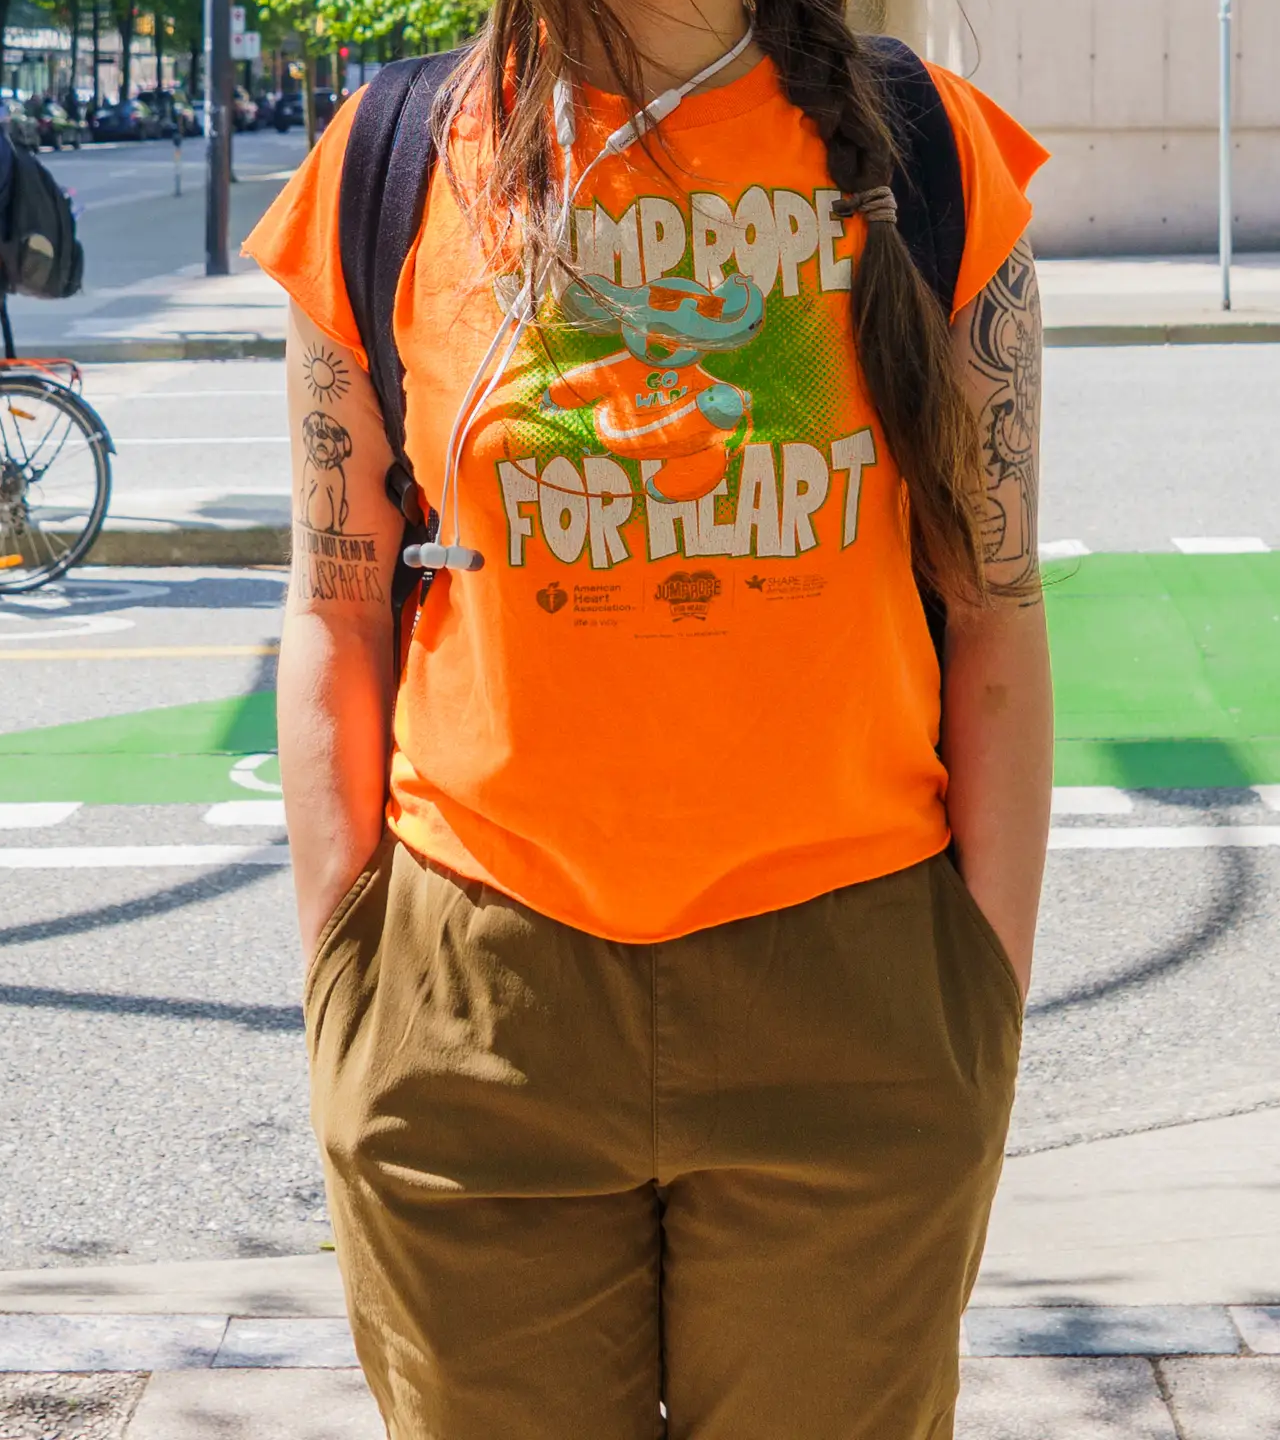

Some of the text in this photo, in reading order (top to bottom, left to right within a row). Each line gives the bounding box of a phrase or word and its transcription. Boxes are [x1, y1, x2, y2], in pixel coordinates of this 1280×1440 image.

[689, 185, 854, 298] ROPE
[646, 370, 679, 390] GO
[496, 428, 877, 570] FOR HEART
[573, 584, 621, 593] American
[573, 593, 610, 604] Heart
